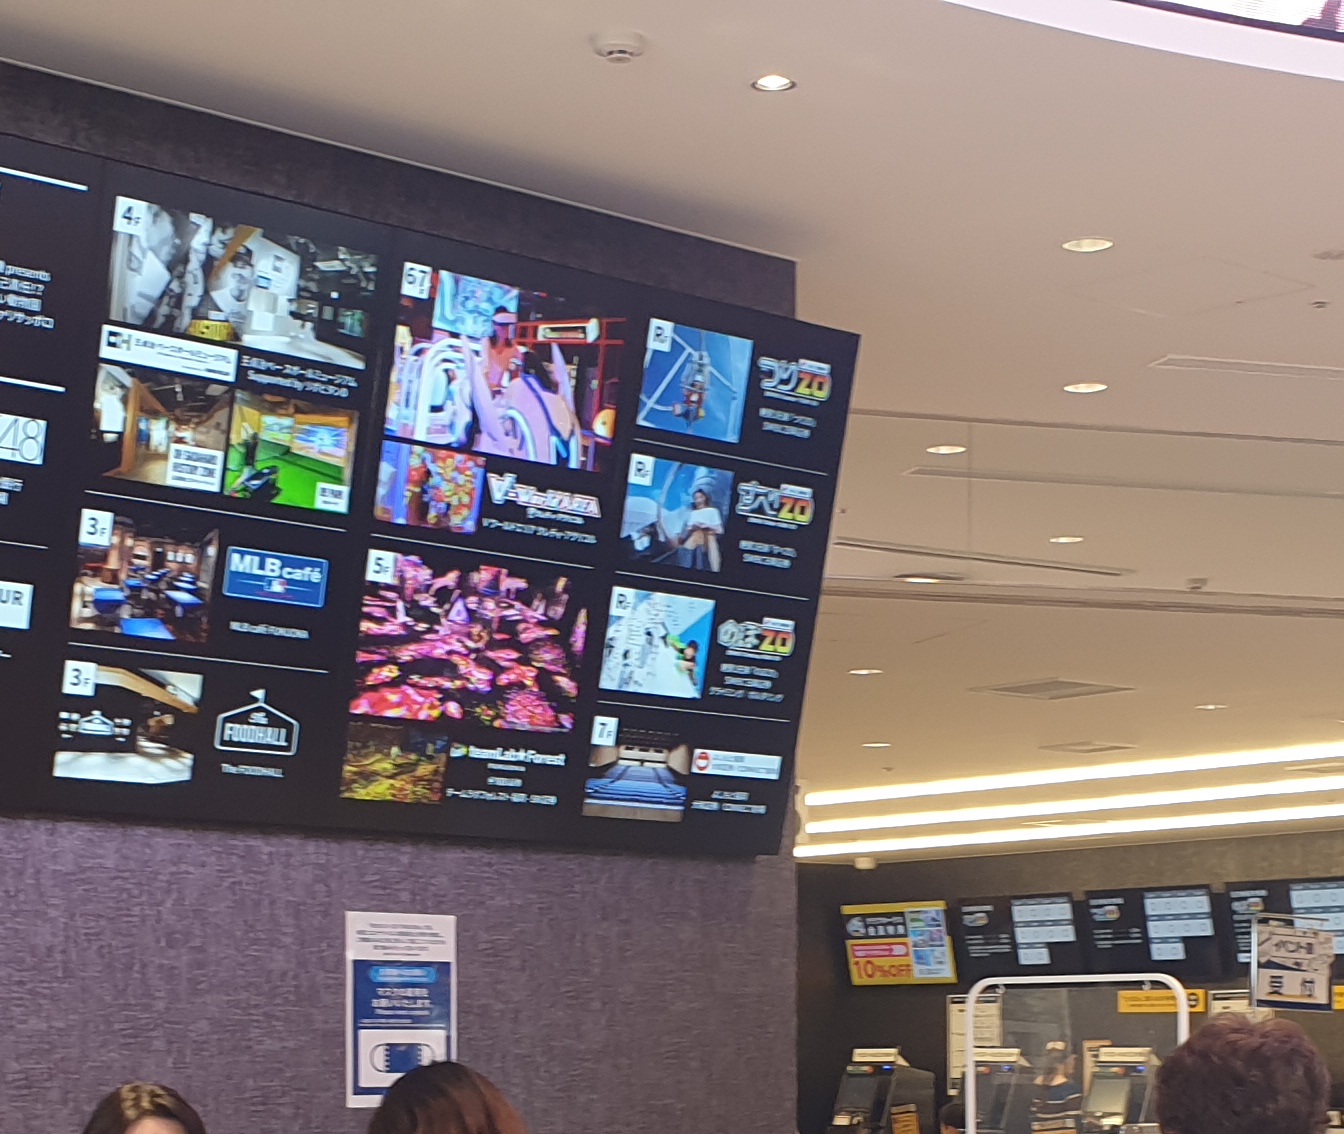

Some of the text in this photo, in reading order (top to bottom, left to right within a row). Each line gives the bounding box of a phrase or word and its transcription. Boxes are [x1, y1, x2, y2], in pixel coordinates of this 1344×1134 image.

[230, 553, 322, 583] MLB café
[224, 725, 288, 746] FOODHALL
